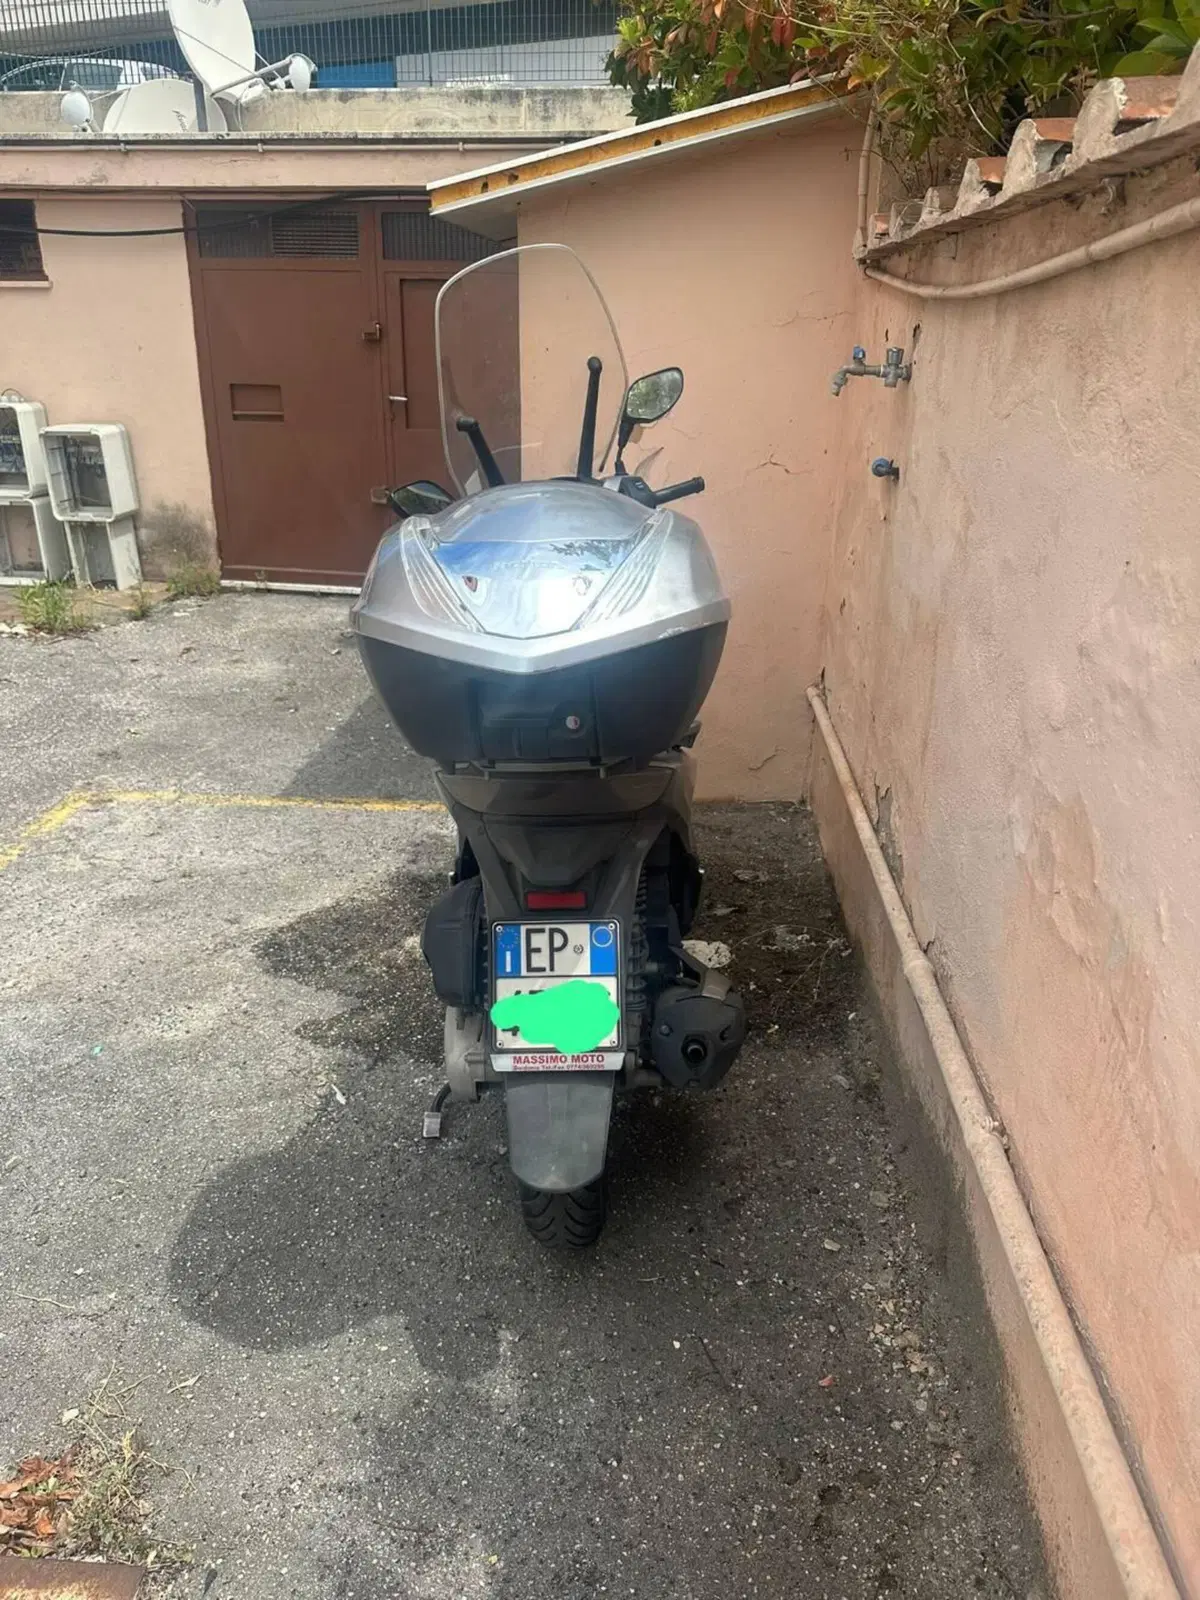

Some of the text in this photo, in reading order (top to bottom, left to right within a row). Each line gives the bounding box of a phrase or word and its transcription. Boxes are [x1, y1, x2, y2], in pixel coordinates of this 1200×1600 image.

[525, 927, 569, 973] EP
[513, 1054, 605, 1064] MASSIMO MOTO
